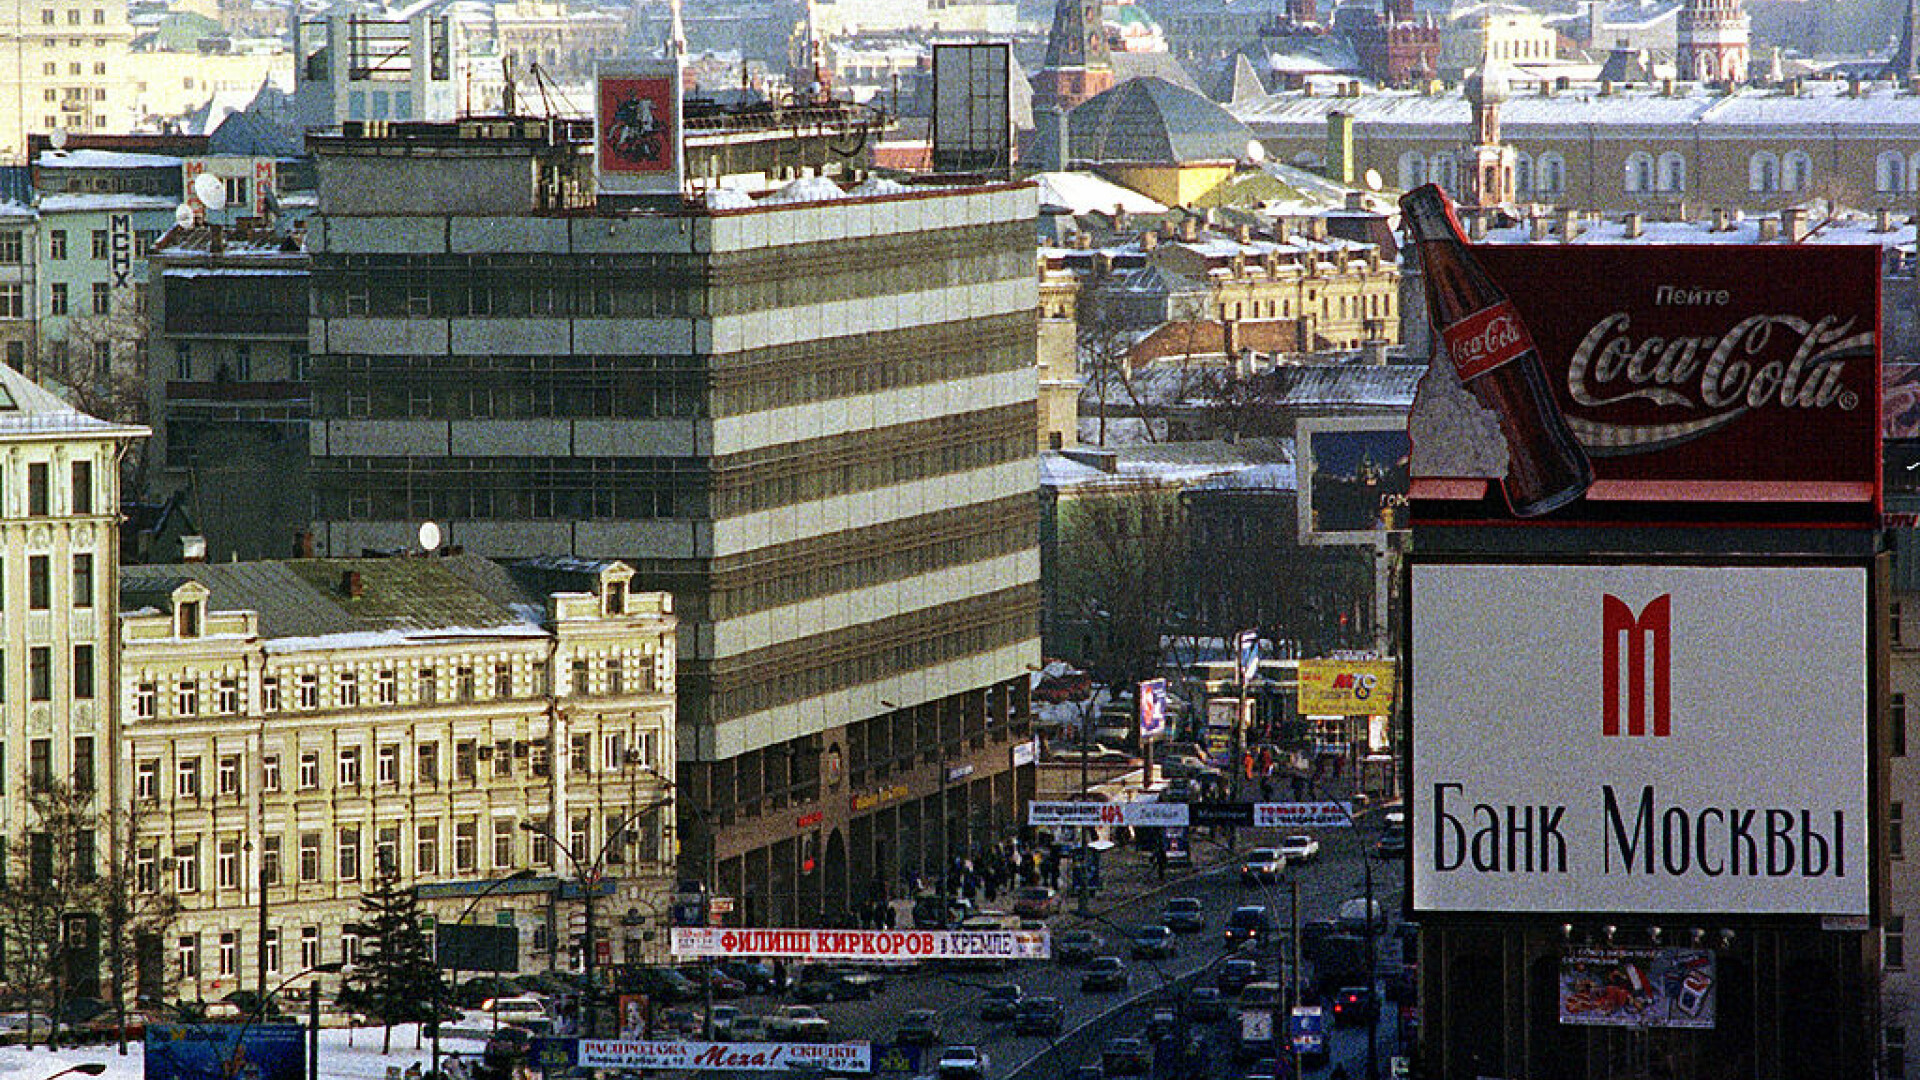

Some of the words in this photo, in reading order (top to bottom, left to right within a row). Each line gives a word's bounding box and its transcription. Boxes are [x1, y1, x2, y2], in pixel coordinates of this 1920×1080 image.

[1655, 285, 1730, 306] Пейте
[1452, 316, 1521, 369] Coca-Cola
[1568, 312, 1858, 408] Coca-Cola
[1433, 782, 1568, 873] Банк
[1602, 784, 1846, 877] Москвы
[721, 931, 811, 953] ФИЛИПП
[816, 932, 935, 955] КИРКОРОВ
[584, 1043, 688, 1056] РАСПРОДАЖА
[693, 1045, 783, 1066] Меха!
